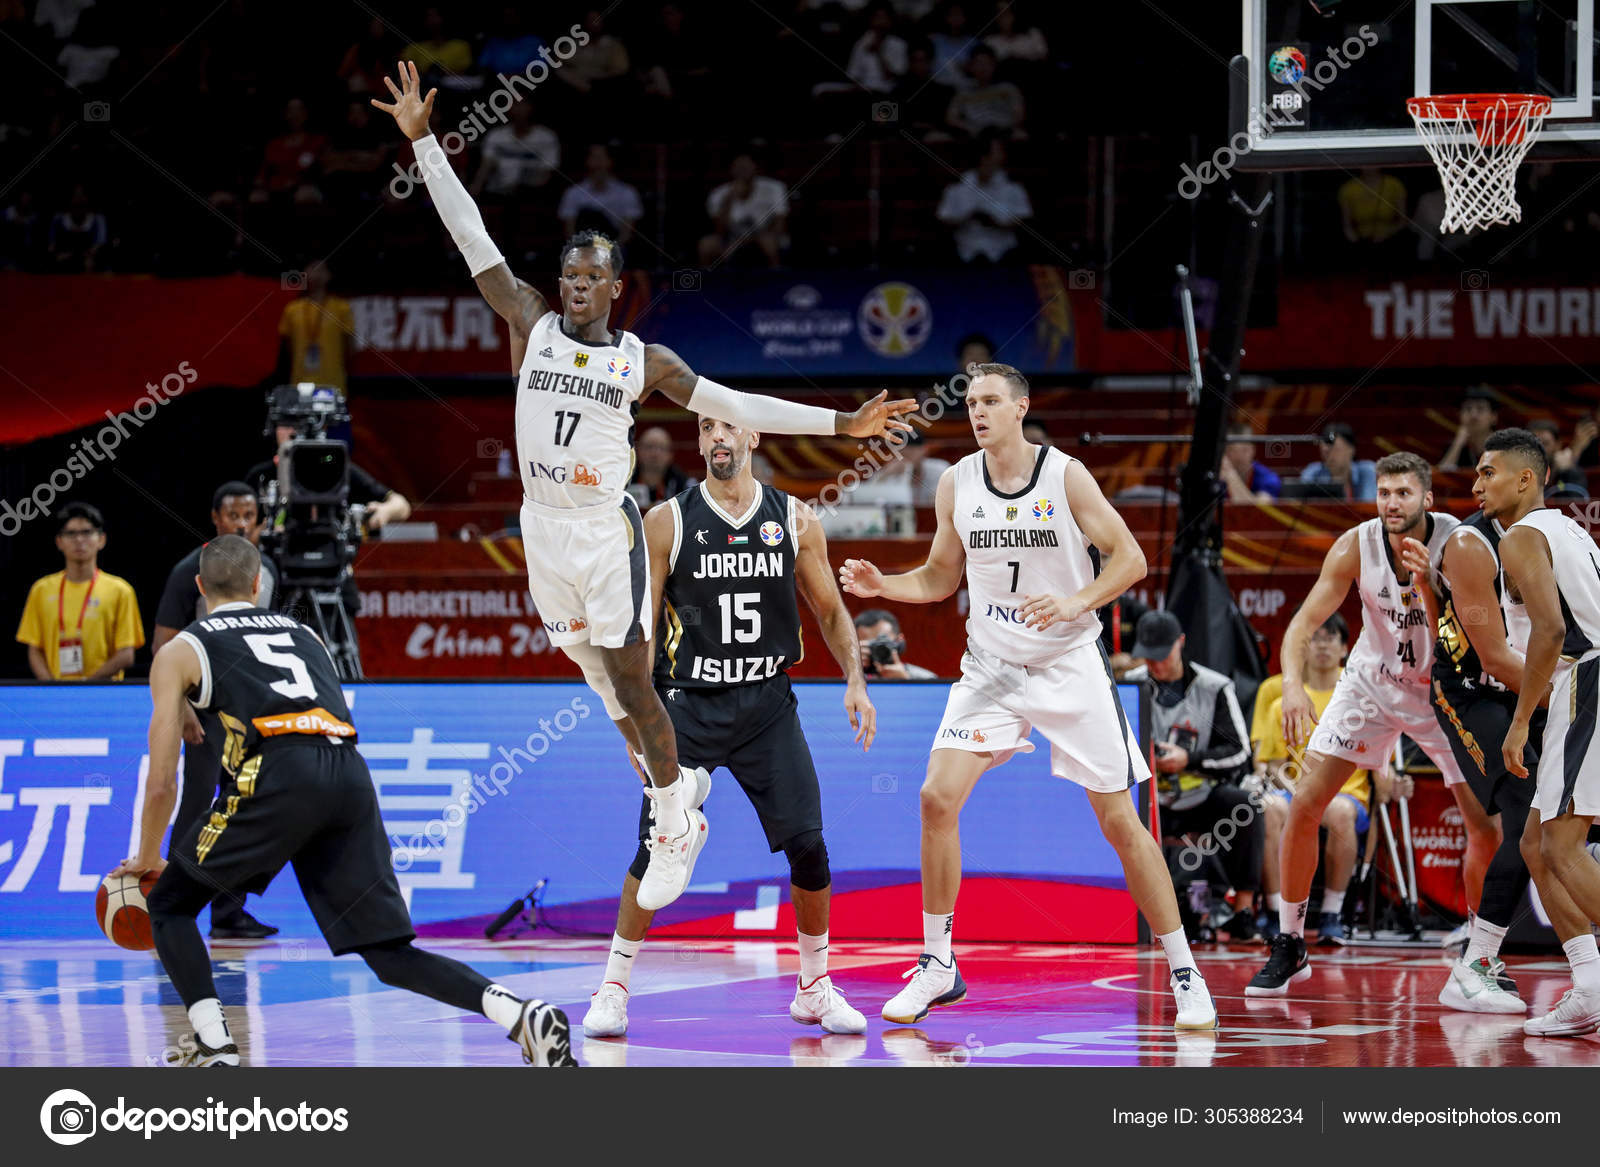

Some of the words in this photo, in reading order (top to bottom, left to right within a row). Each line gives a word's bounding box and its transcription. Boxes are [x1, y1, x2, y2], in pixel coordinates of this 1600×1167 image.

[1272, 93, 1302, 109] FIBA
[1365, 282, 1455, 340] THE
[528, 369, 624, 409] DEUTSCHLAND
[554, 410, 582, 447] 17
[529, 461, 567, 484] ING
[969, 529, 1059, 549] DEUTSCHLAND
[693, 552, 783, 579] JORDAN
[1007, 561, 1020, 593] 7
[387, 590, 521, 618] BASKETBALL
[1239, 588, 1286, 617] CUP
[200, 614, 299, 632] IBRAHIM
[543, 621, 567, 633] NG
[718, 592, 761, 644] 15
[406, 621, 503, 660] China
[242, 631, 318, 700] 5
[691, 655, 786, 683] ISUZU
[264, 714, 351, 737] orange
[942, 728, 970, 740] ING
[1329, 734, 1355, 750] ING
